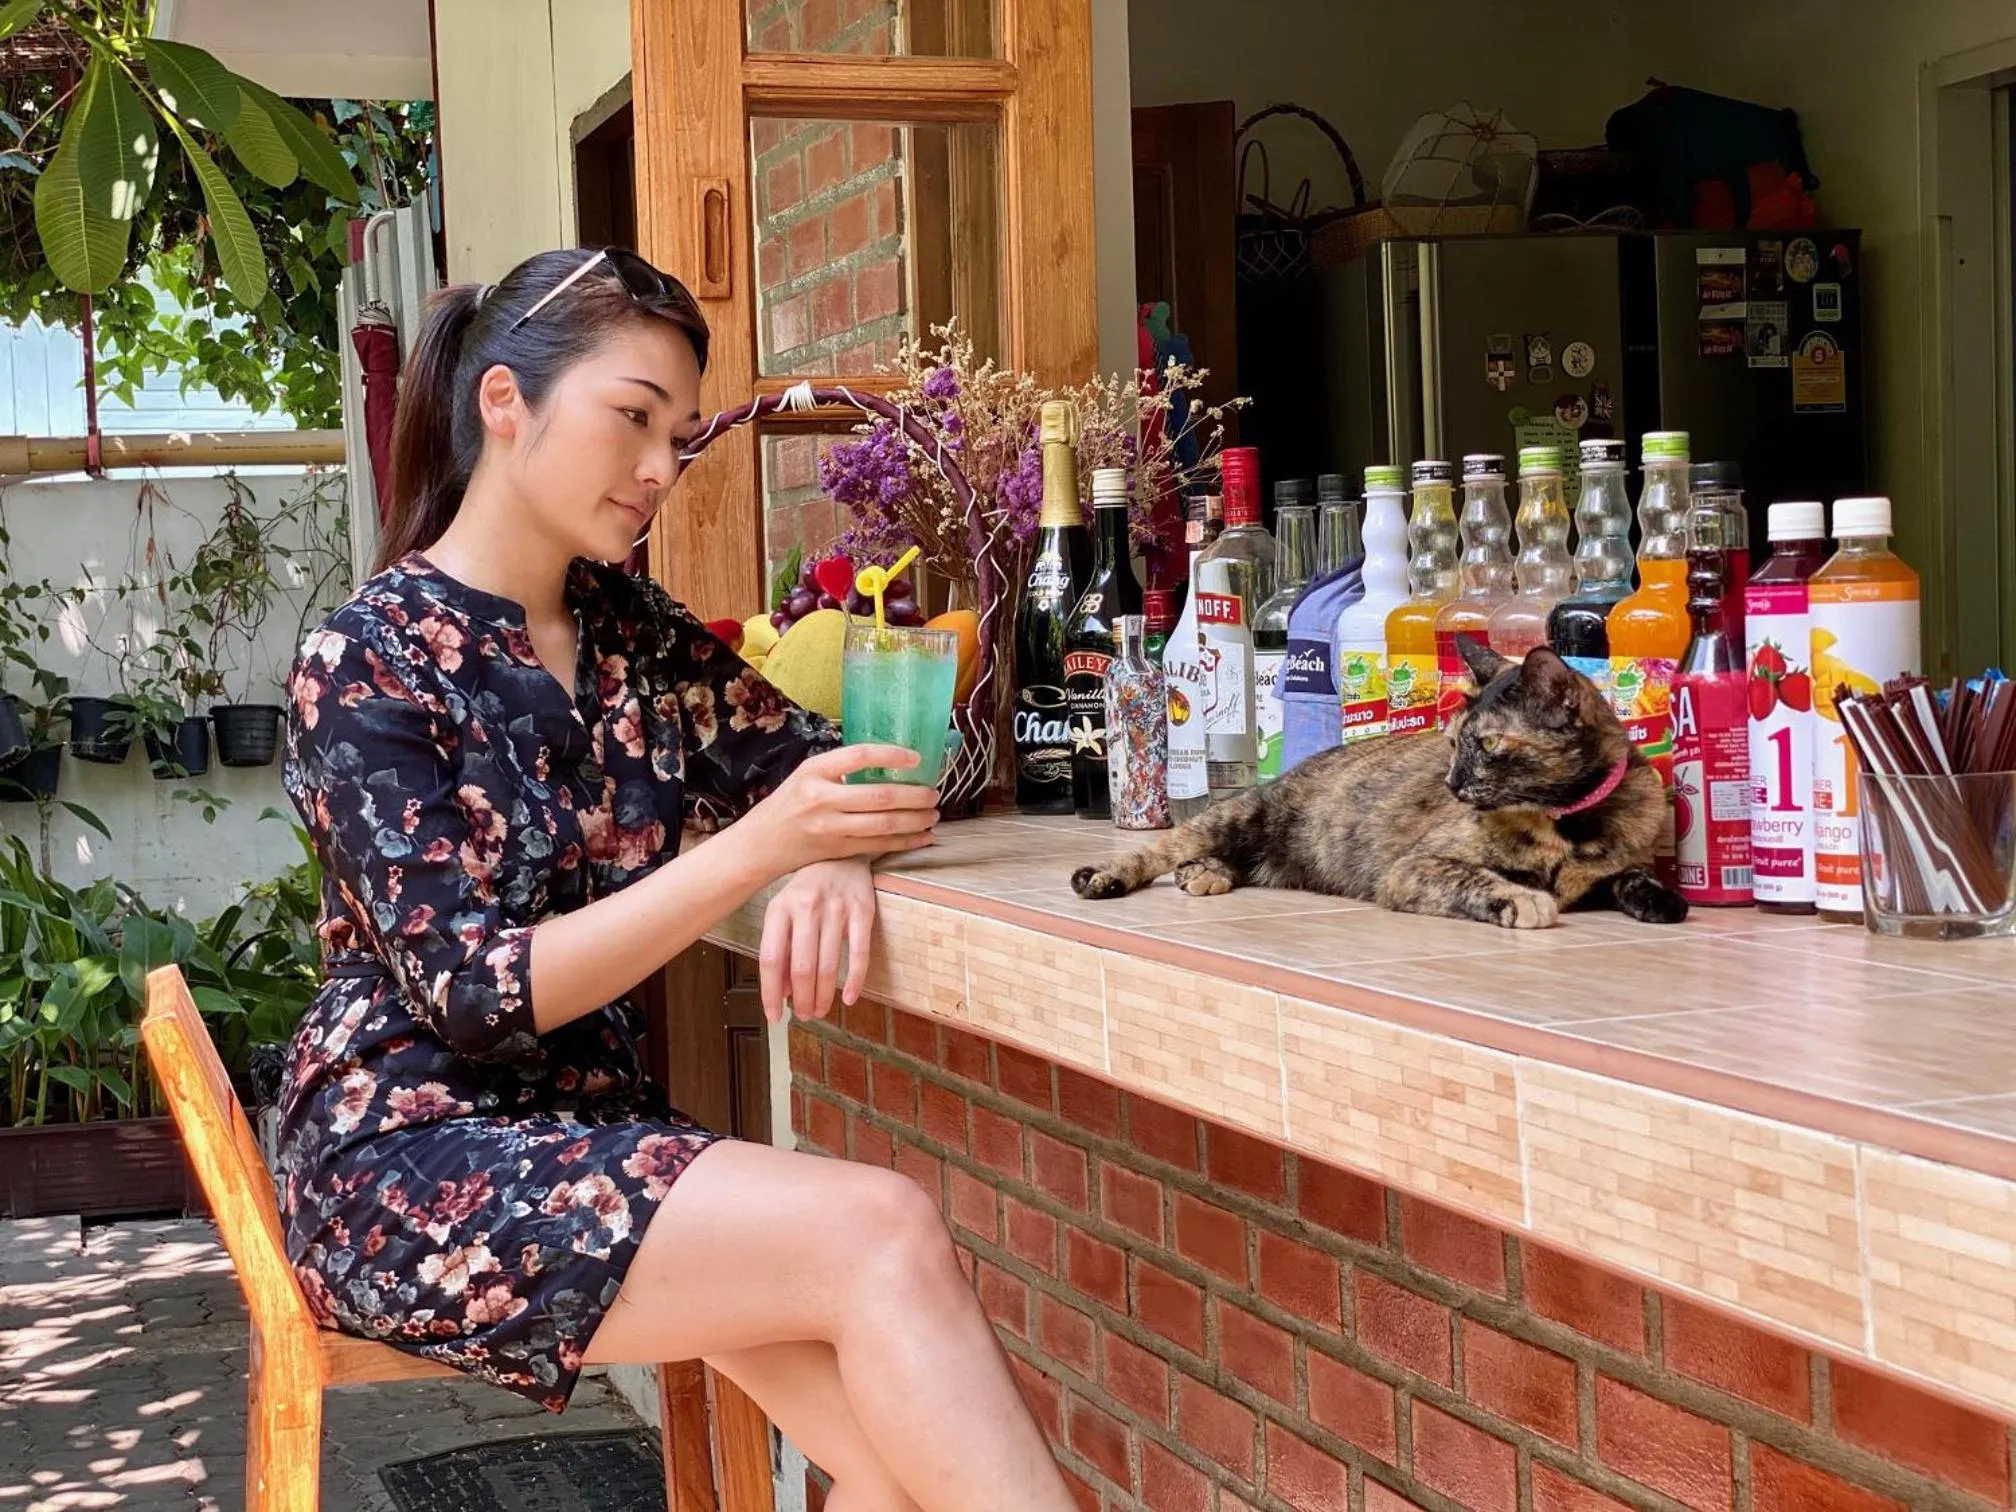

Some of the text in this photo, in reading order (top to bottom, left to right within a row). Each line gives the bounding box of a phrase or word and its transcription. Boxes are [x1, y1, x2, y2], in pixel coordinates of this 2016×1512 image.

[1028, 572, 1070, 590] Chang
[1198, 599, 1232, 619] NOFF
[1064, 655, 1108, 674] AILEY
[1286, 654, 1326, 673] Beach
[1768, 726, 1804, 812] 1
[1814, 824, 1852, 842] ango
